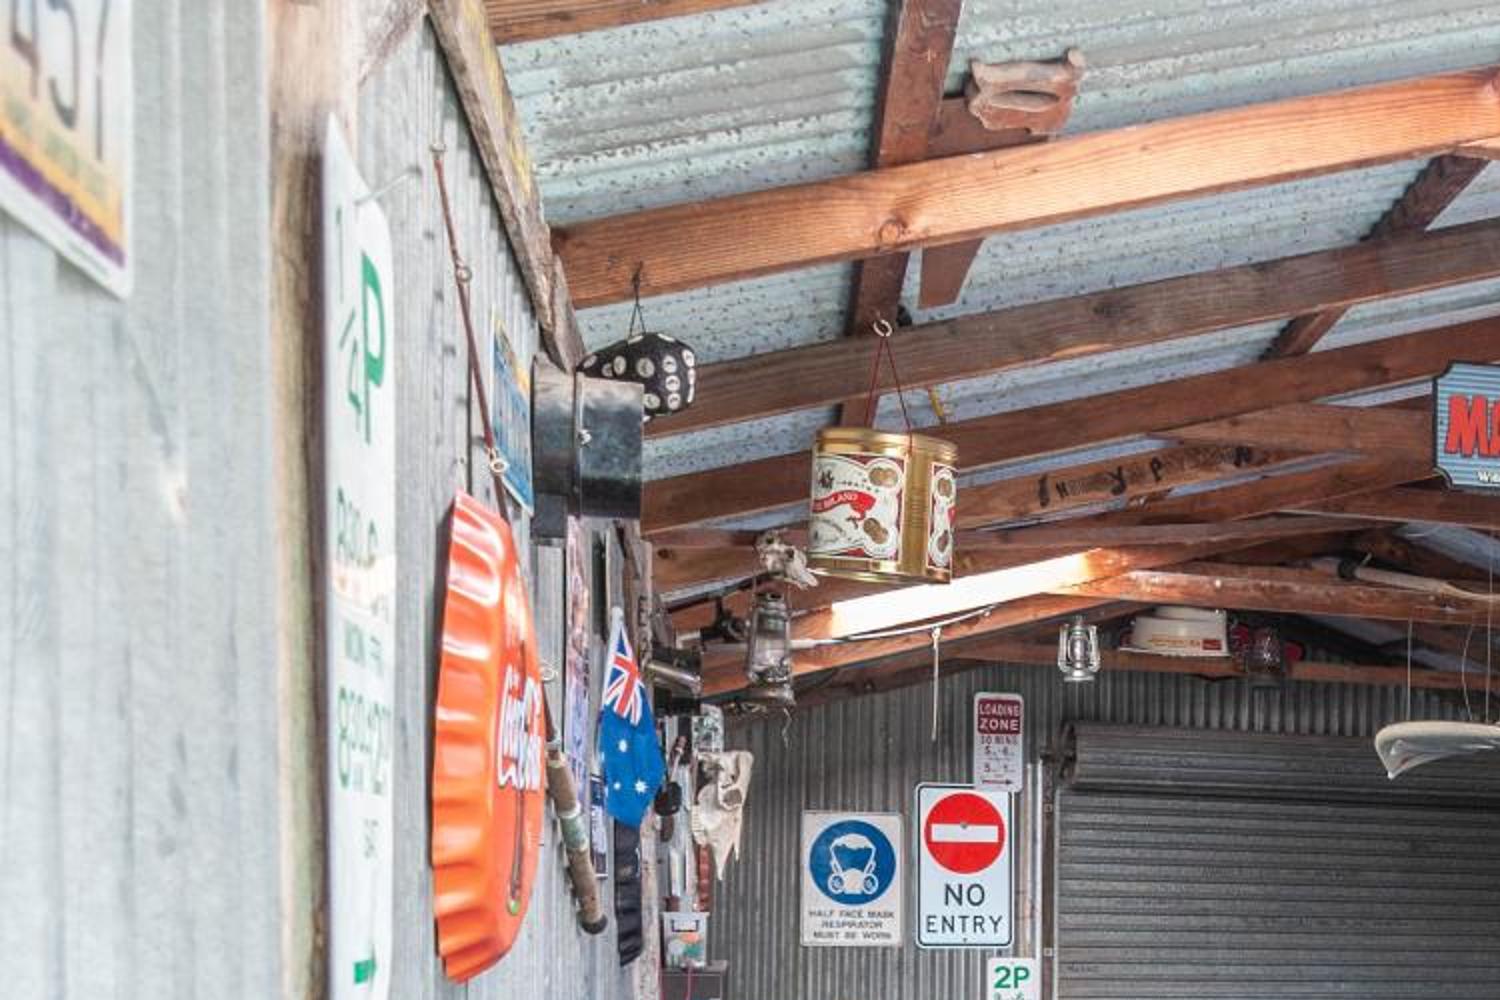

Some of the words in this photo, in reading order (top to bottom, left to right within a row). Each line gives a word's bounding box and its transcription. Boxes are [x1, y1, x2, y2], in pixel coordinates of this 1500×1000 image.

[979, 703, 1019, 717] LOADING
[979, 719, 1019, 731] ZONE
[944, 883, 985, 907] NO
[926, 915, 1003, 935] ENTRY
[993, 965, 1030, 989] 2P
